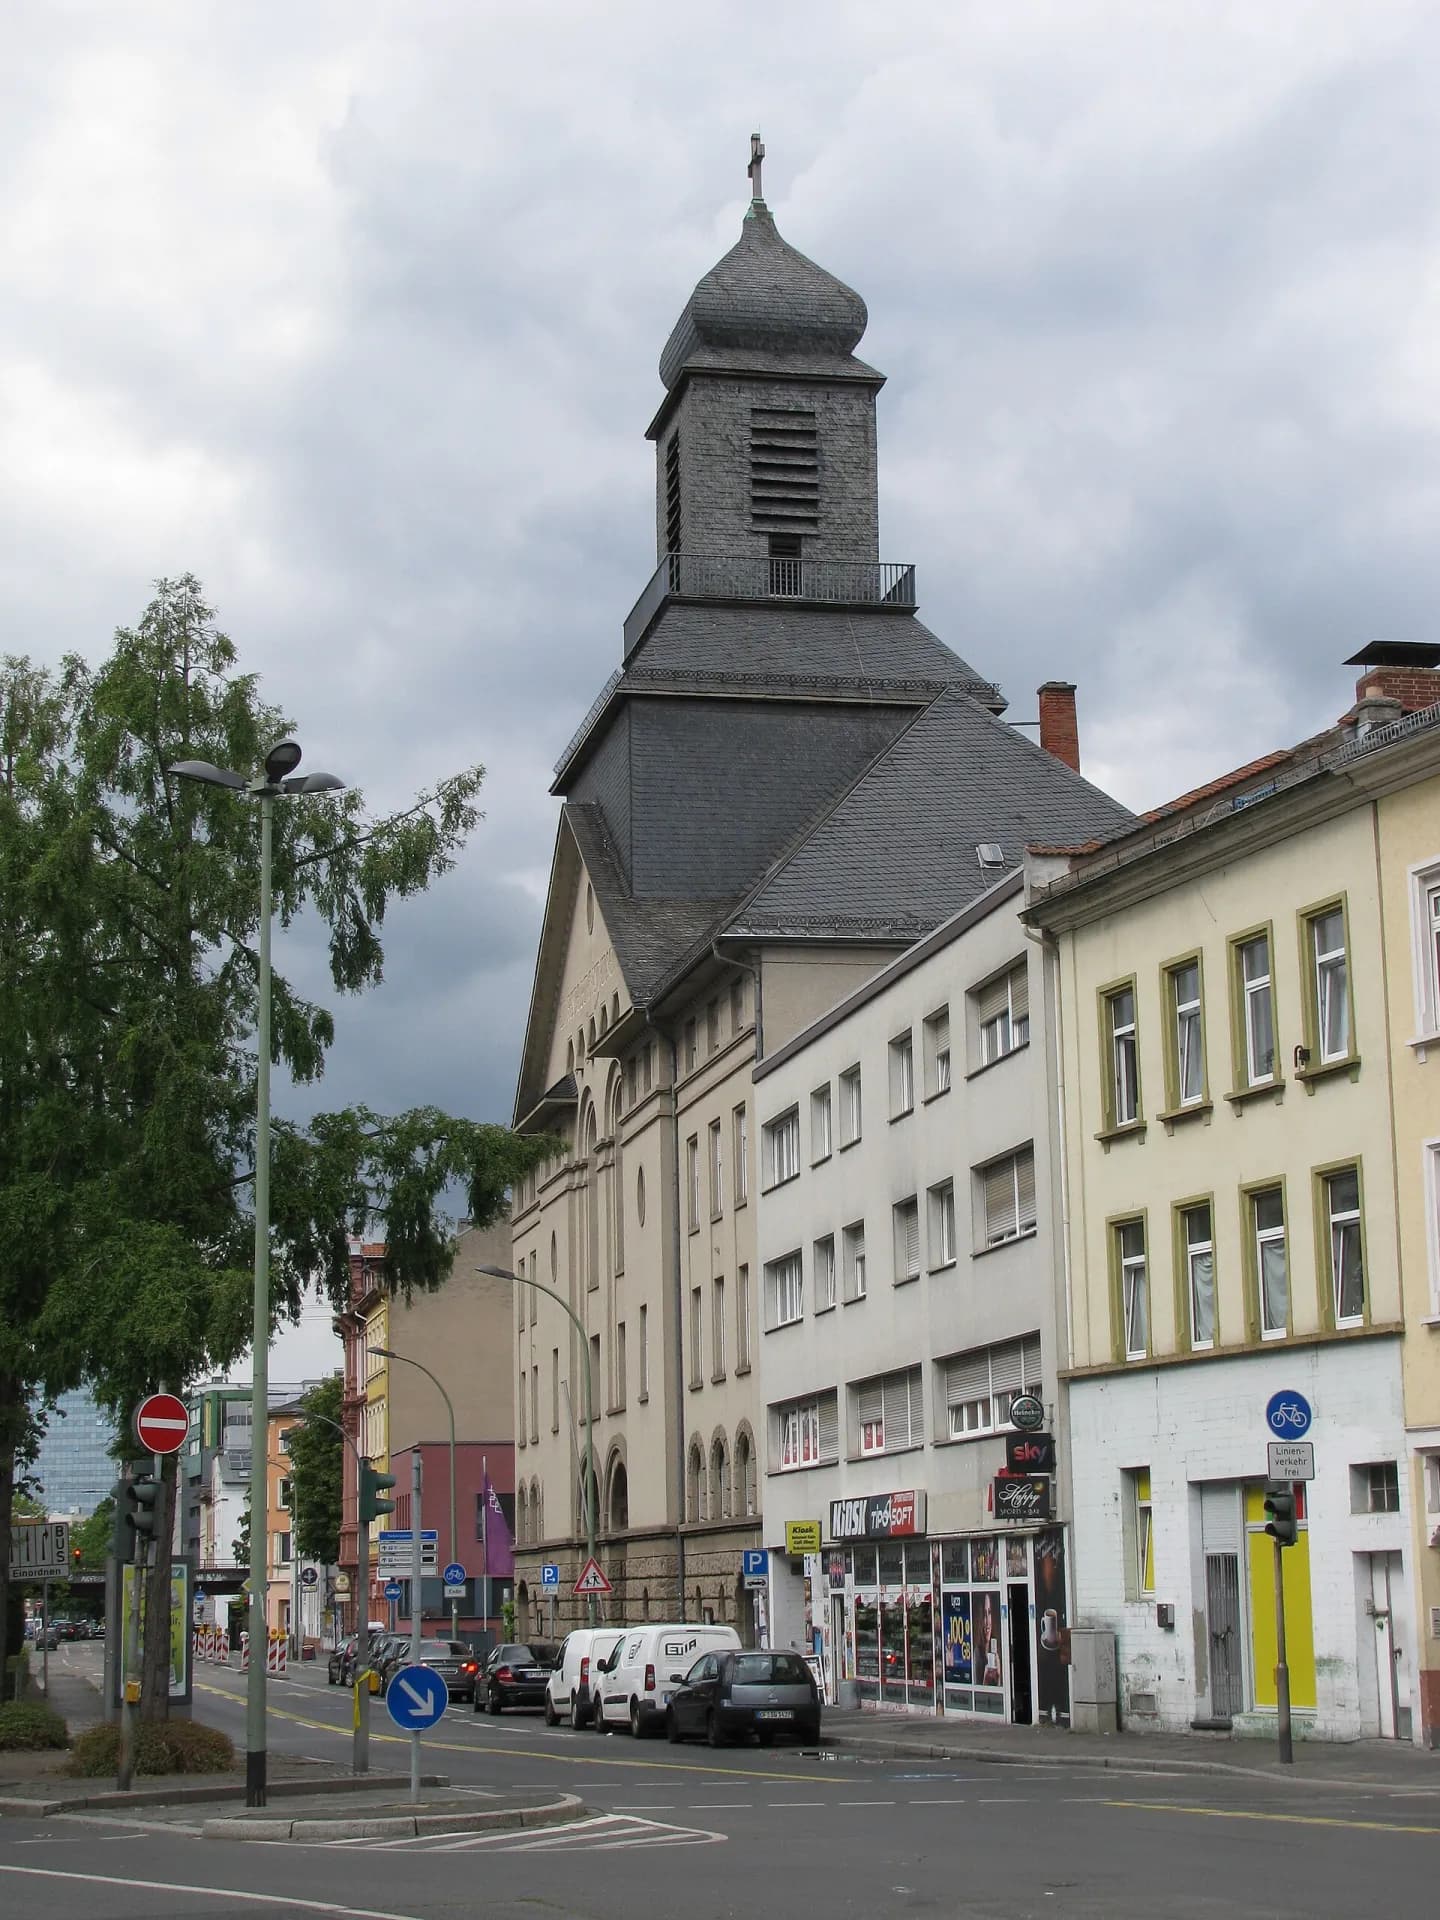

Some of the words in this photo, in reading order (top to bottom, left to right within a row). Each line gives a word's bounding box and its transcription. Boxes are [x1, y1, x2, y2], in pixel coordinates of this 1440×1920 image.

[1013, 1441, 1048, 1463] sky
[1275, 1447, 1305, 1456] Linien-
[1274, 1457, 1308, 1466] verkehr
[1284, 1467, 1299, 1477] frei
[998, 1483, 1041, 1509] Happy
[792, 1526, 815, 1534] Kiosk
[55, 1525, 65, 1563] BUS
[749, 1553, 763, 1572] P
[12, 1568, 62, 1578] Einordnen
[544, 1568, 553, 1582] P
